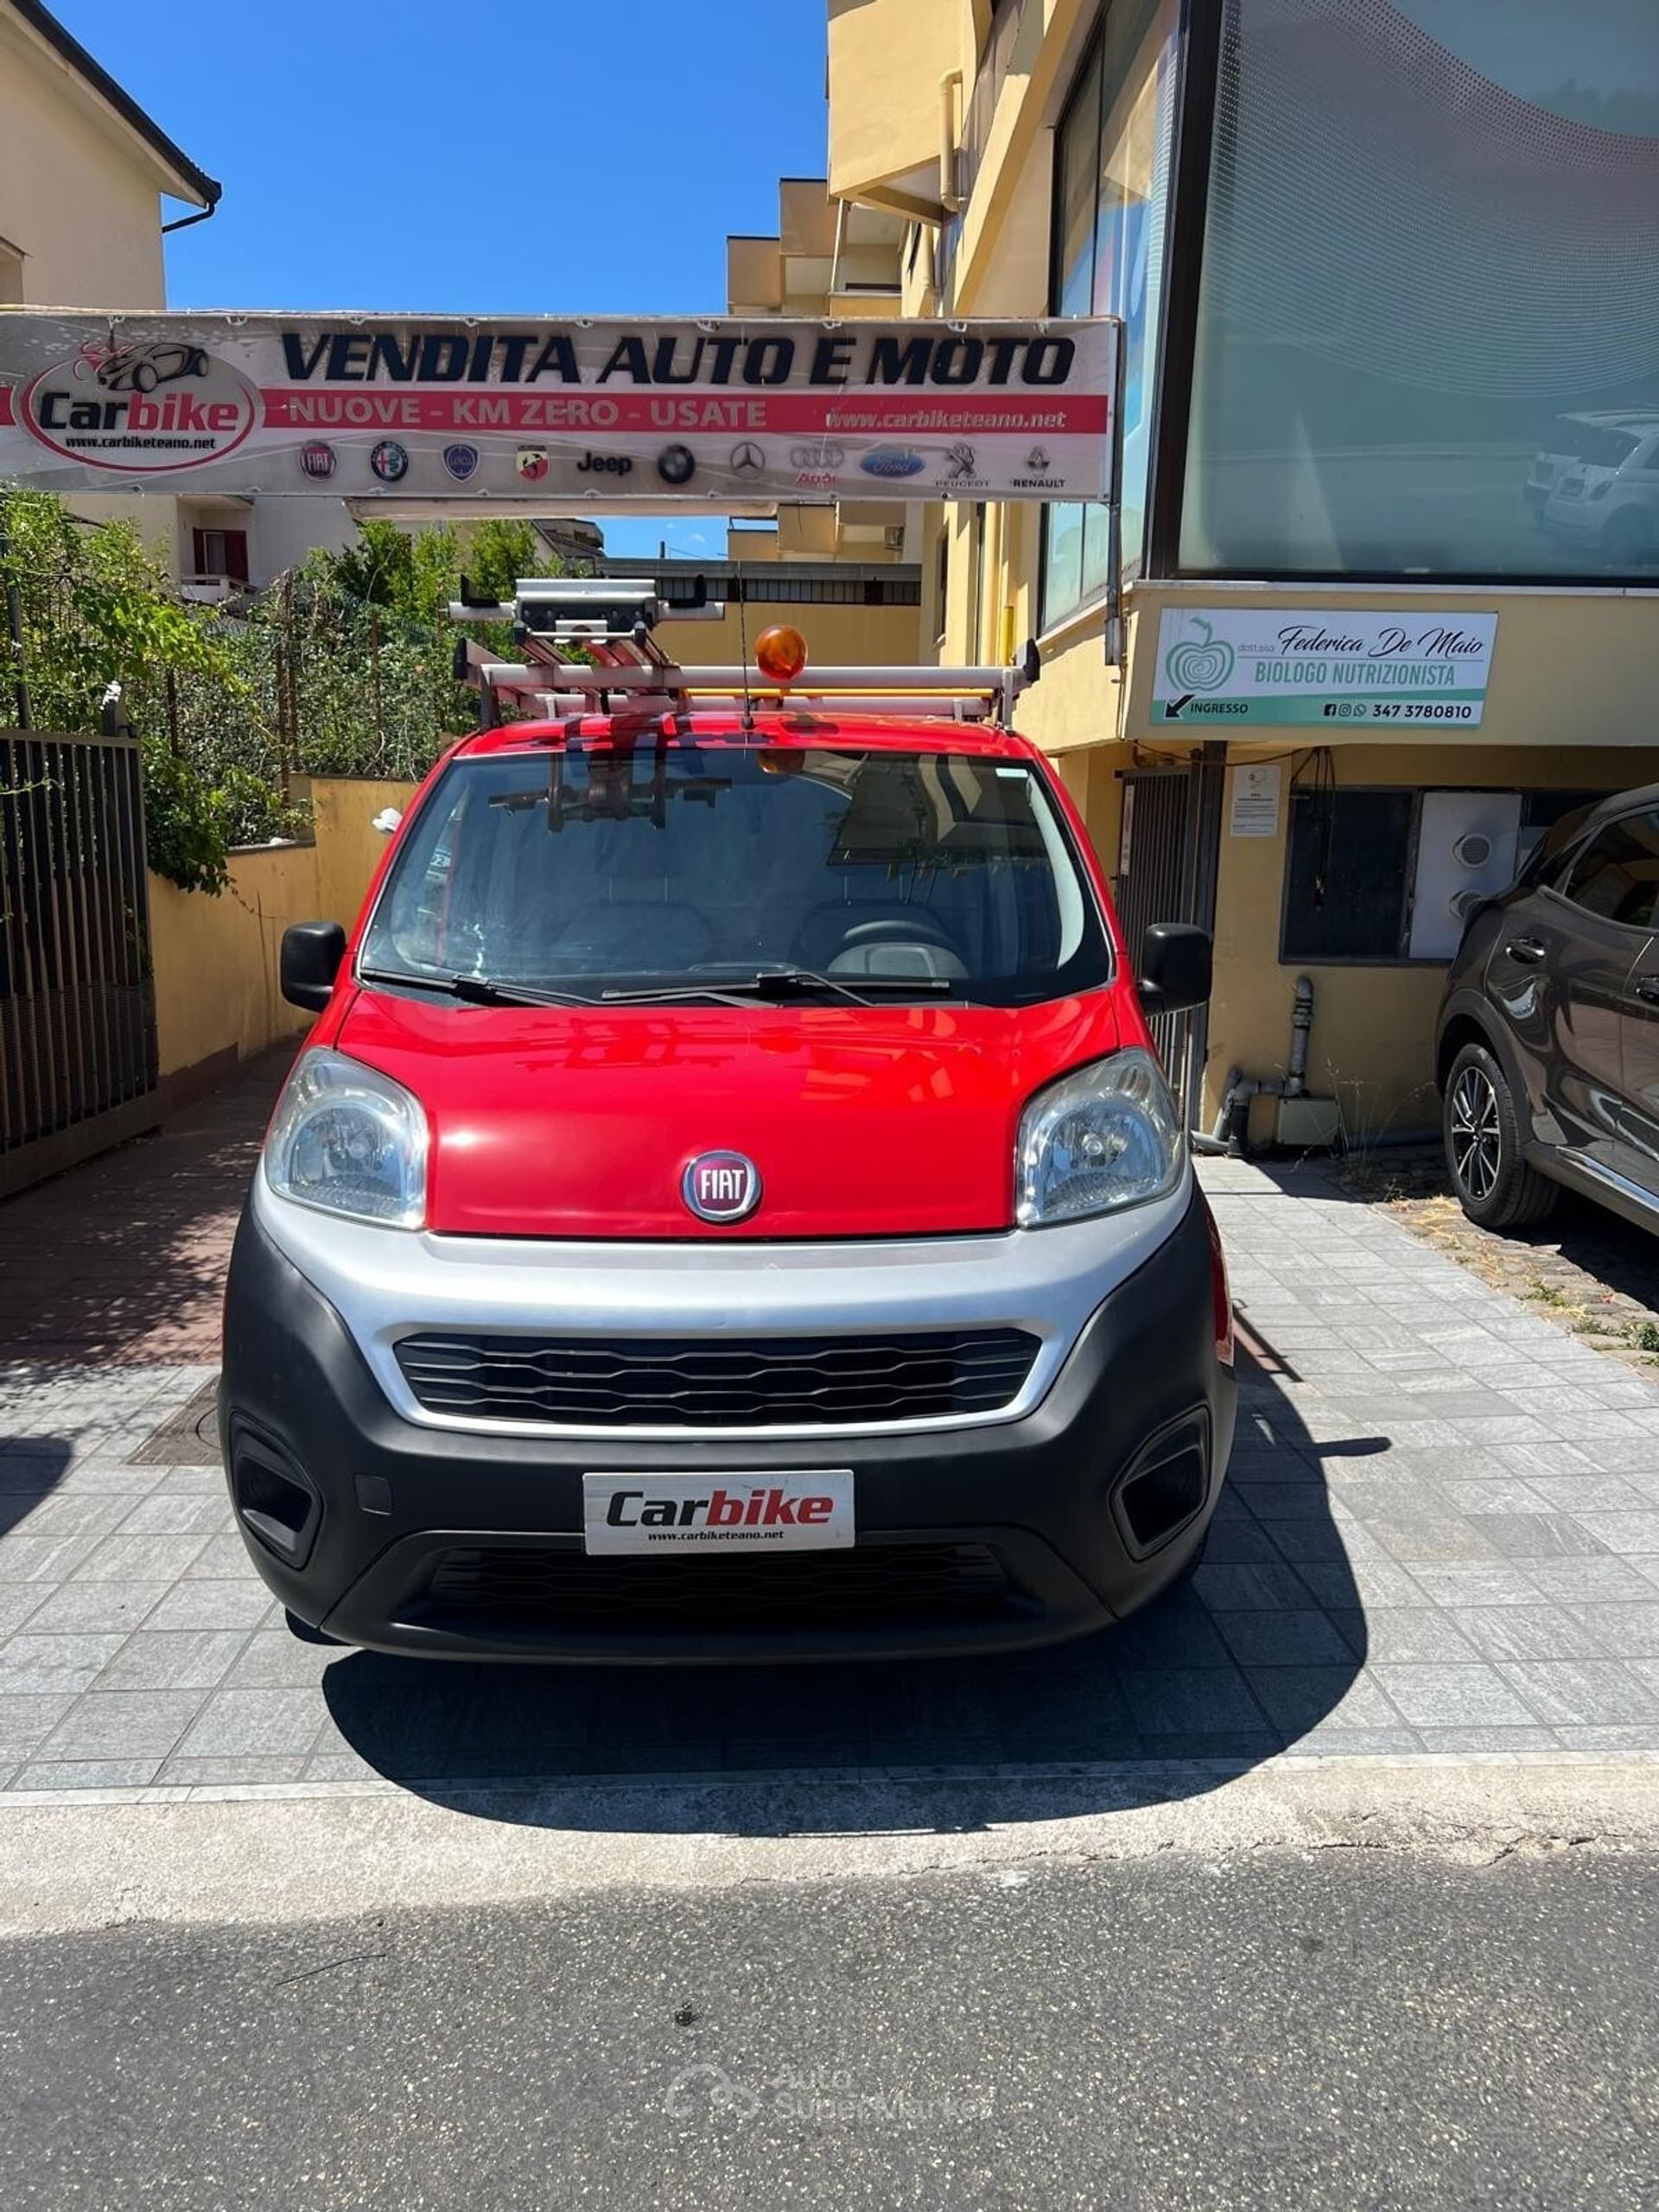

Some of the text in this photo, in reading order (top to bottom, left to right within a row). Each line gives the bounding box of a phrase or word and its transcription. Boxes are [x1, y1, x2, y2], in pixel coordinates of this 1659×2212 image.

[282, 333, 1076, 385] VENDITA AUTO E MOTO
[39, 392, 239, 432] Carbike
[289, 396, 422, 423] NUOVE
[453, 398, 511, 424] KM
[520, 399, 620, 426] ZERO
[650, 400, 766, 427] USATE
[825, 410, 1066, 429] www.carbiketeano.net
[66, 435, 216, 449] www.carbiketeano.net
[307, 453, 329, 472] FIAT
[576, 451, 633, 476] Jeep
[1013, 479, 1066, 488] RENAULT
[1277, 625, 1367, 656] Federica
[1367, 626, 1414, 658] De
[1417, 627, 1484, 659] Maio
[1255, 661, 1456, 686] BIOLOGO NUTRIZIONISTA
[1189, 702, 1249, 715] INGRESSO
[1371, 704, 1472, 719] 347 3780810
[700, 1169, 745, 1200] FIAT
[606, 1489, 835, 1528] Carbike
[647, 1529, 785, 1542] www.carbiketeano.net
